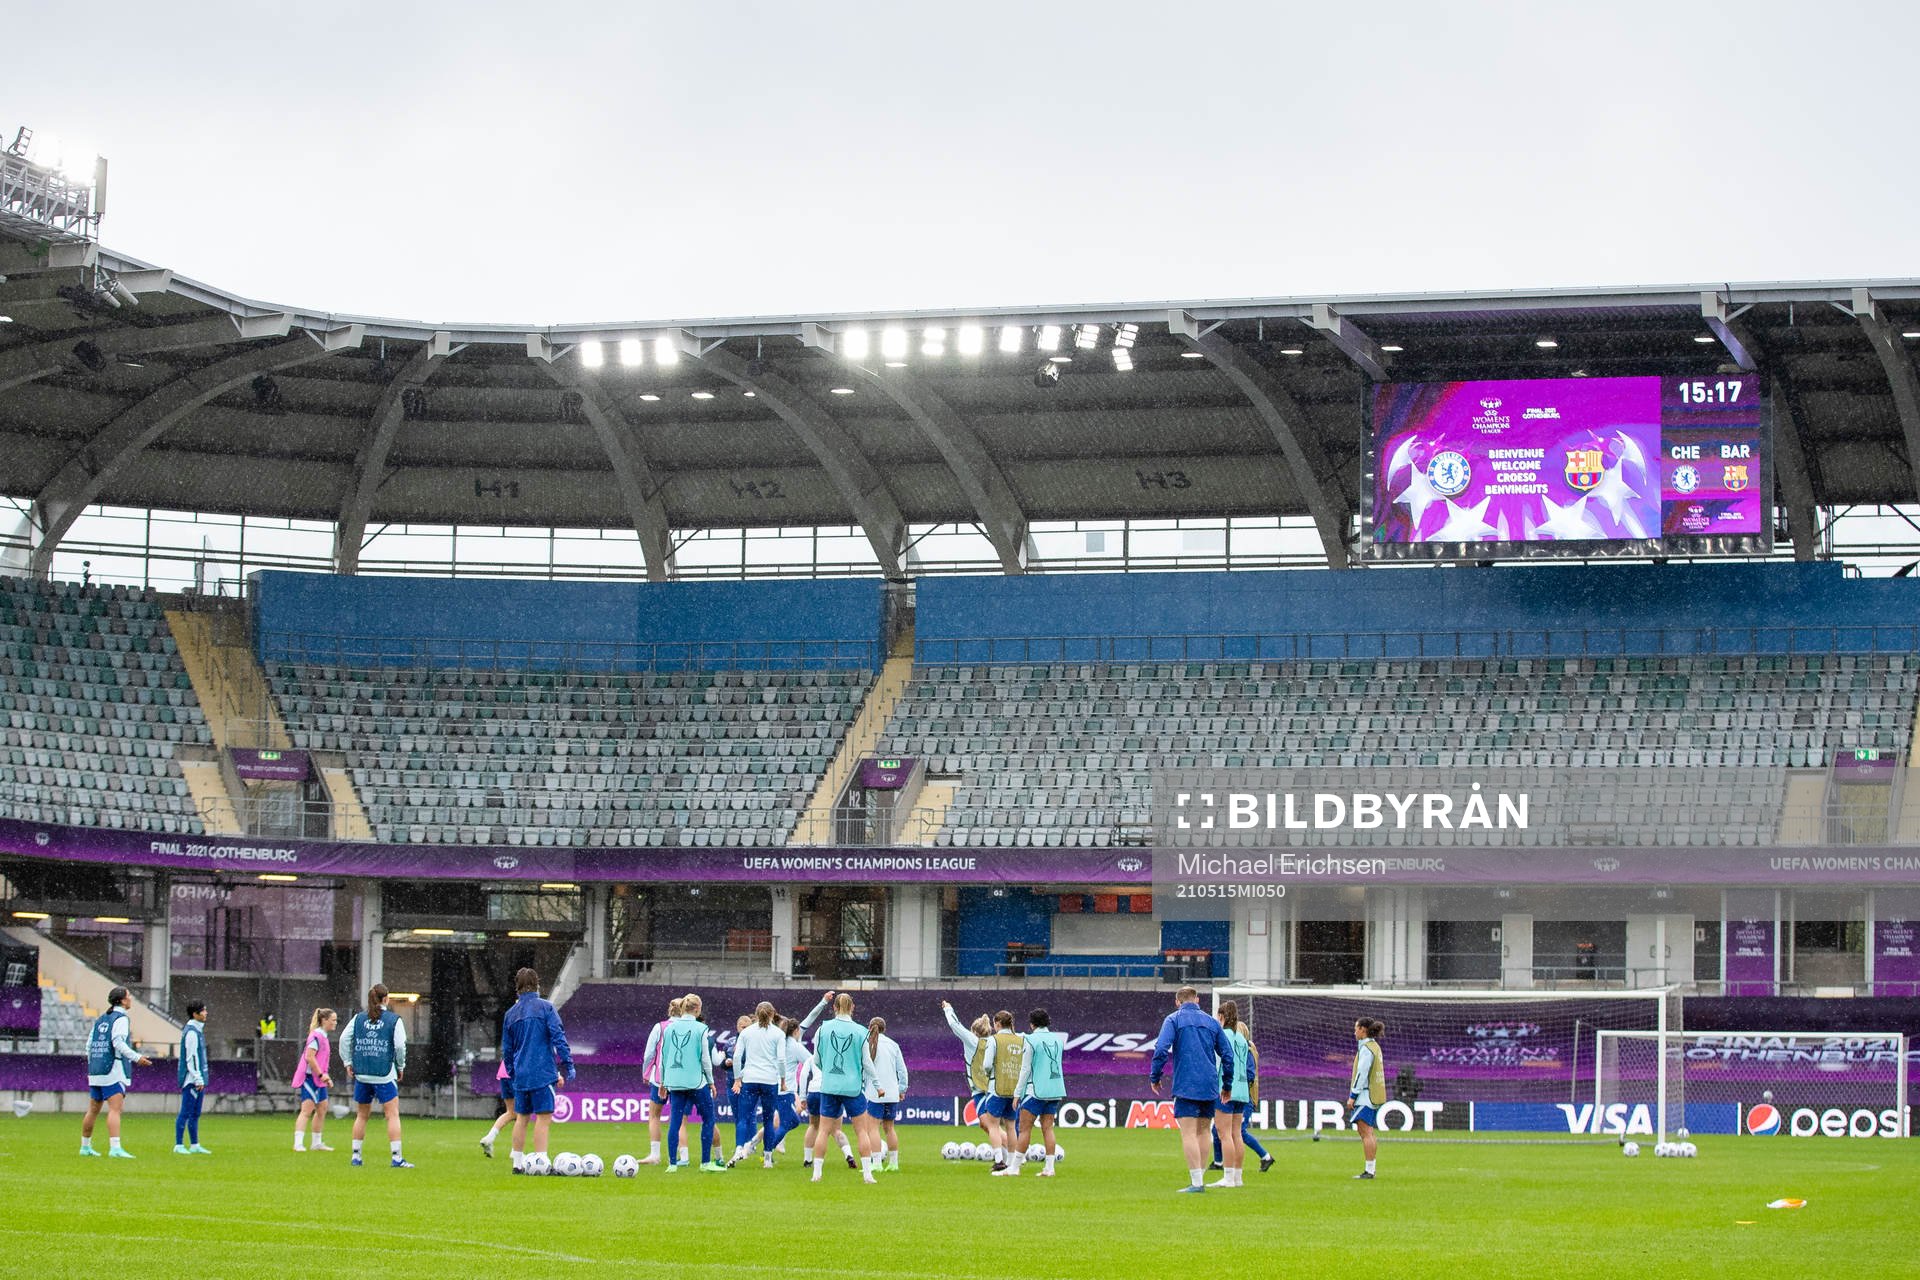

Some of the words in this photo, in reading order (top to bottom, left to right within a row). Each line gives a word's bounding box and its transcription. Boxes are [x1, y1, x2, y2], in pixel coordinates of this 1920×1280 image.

[1679, 381, 1742, 403] 15:17
[1472, 415, 1510, 423] WOMEN'S
[1488, 448, 1545, 459] BIENVENUE
[1671, 446, 1700, 459] CHE
[1720, 444, 1750, 459] BAR
[1491, 460, 1542, 471] WELCOME
[1135, 469, 1192, 490] H3
[1496, 472, 1537, 483] CROESO
[474, 479, 519, 498] H1
[728, 478, 787, 499] H2
[1484, 484, 1549, 495] BENVINGUTS
[848, 789, 861, 808] H2
[150, 841, 185, 856] FINAL
[185, 844, 208, 857] 2021
[208, 846, 298, 863] GOTHENBURG
[743, 857, 780, 869] UEFA
[781, 857, 843, 870] WOMEN'S
[845, 857, 923, 870] CHAMPIONS
[925, 857, 976, 870] LEAGUE
[1770, 857, 1811, 870] UEFA
[1812, 857, 1880, 871] WOMEN'S
[355, 1045, 388, 1053] CHAMPIONS
[356, 1038, 389, 1047] WOMEN'S
[1696, 1035, 1813, 1050] FINAL
[1821, 1036, 1899, 1051] 2021
[906, 1107, 951, 1123] Disney
[1556, 1103, 1654, 1135] VISA
[1791, 1104, 1911, 1138] pepsi
